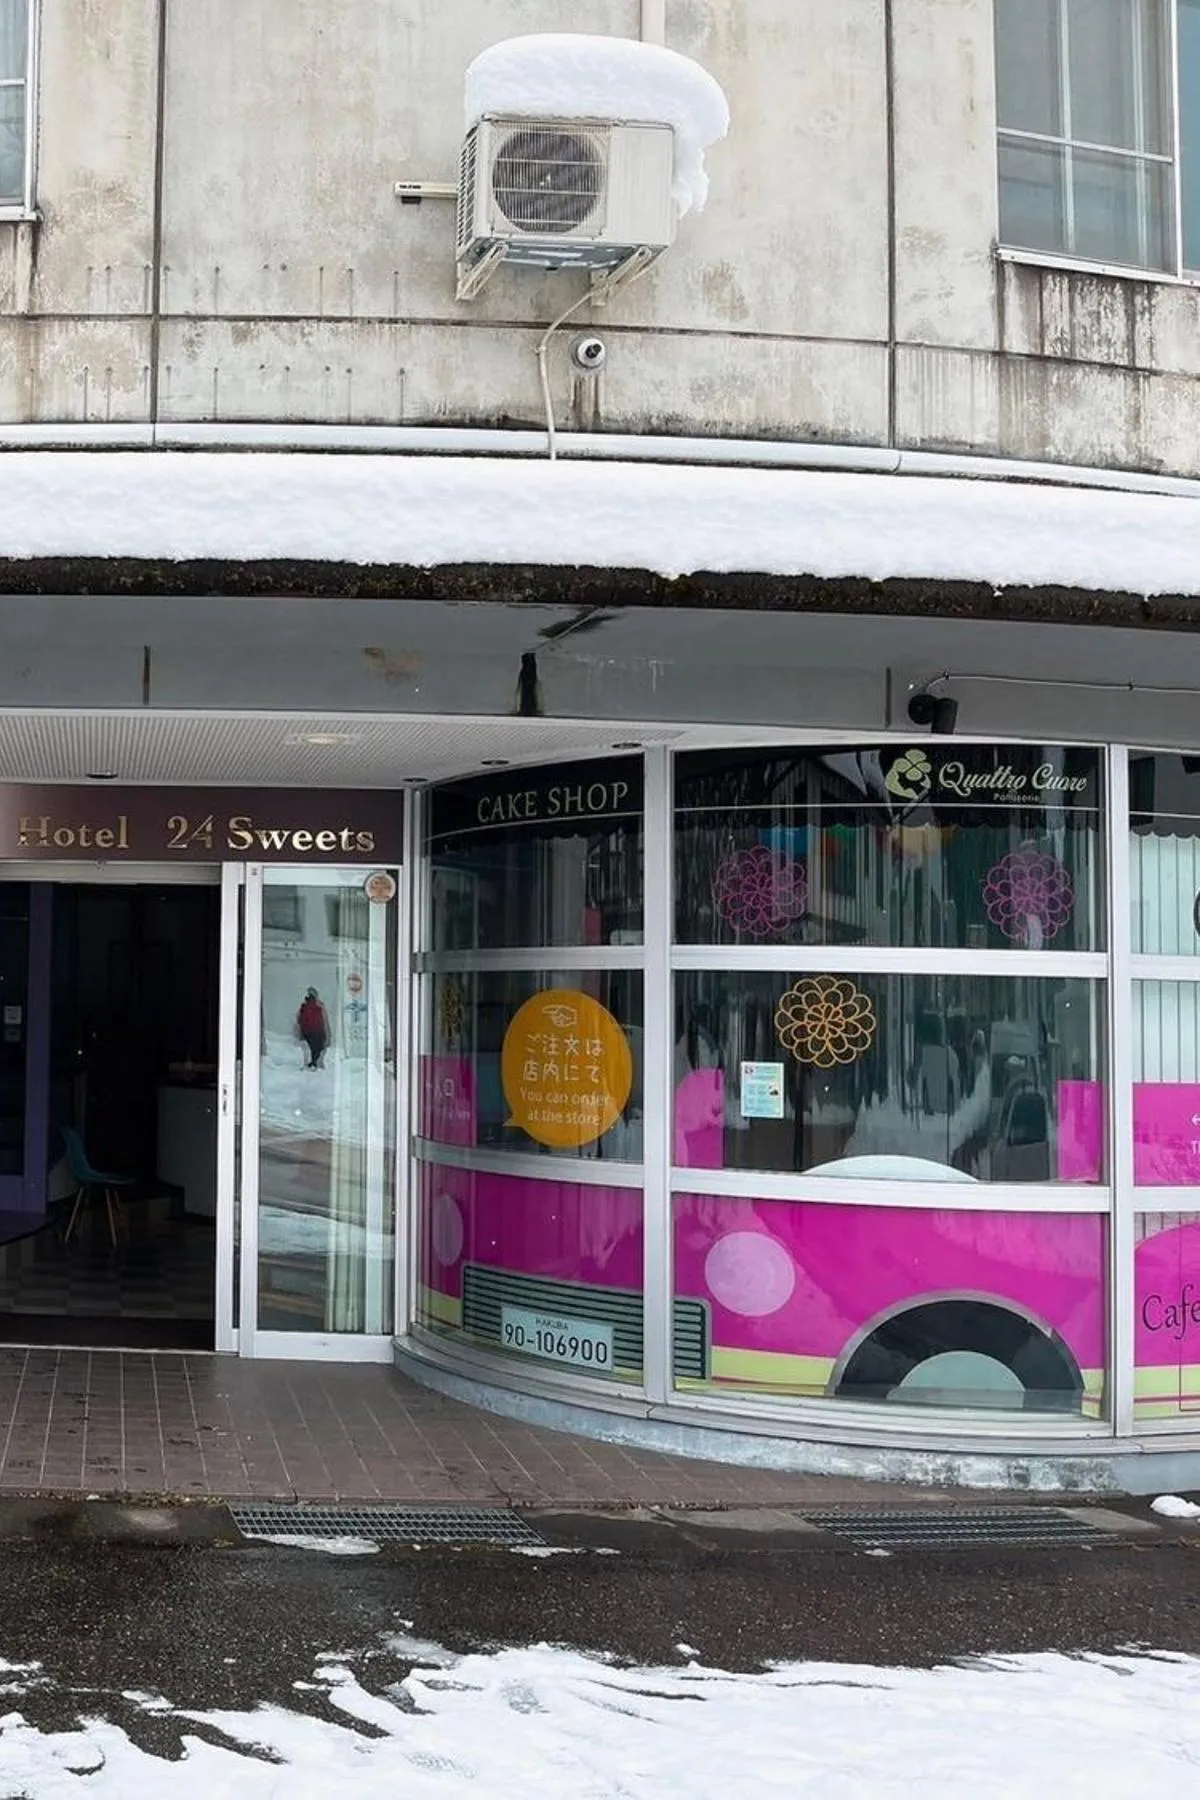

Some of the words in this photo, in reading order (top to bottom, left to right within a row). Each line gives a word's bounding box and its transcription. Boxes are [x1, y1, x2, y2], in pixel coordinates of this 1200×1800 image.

[939, 761, 1028, 796] Quattro
[1031, 763, 1087, 791] Cuore
[477, 791, 537, 822] CAKE
[547, 781, 628, 815] SHOP
[17, 815, 129, 849] Hotel
[167, 815, 214, 849] 24
[228, 815, 375, 852] Sweets
[527, 1032, 604, 1056] ご注文は
[523, 1059, 600, 1083] 店内にて
[520, 1086, 542, 1102] You
[545, 1091, 568, 1104] can
[571, 1090, 610, 1106] order
[528, 1109, 539, 1121] at
[541, 1108, 563, 1122] the
[565, 1111, 600, 1125] store
[504, 1323, 607, 1364] 90-106900
